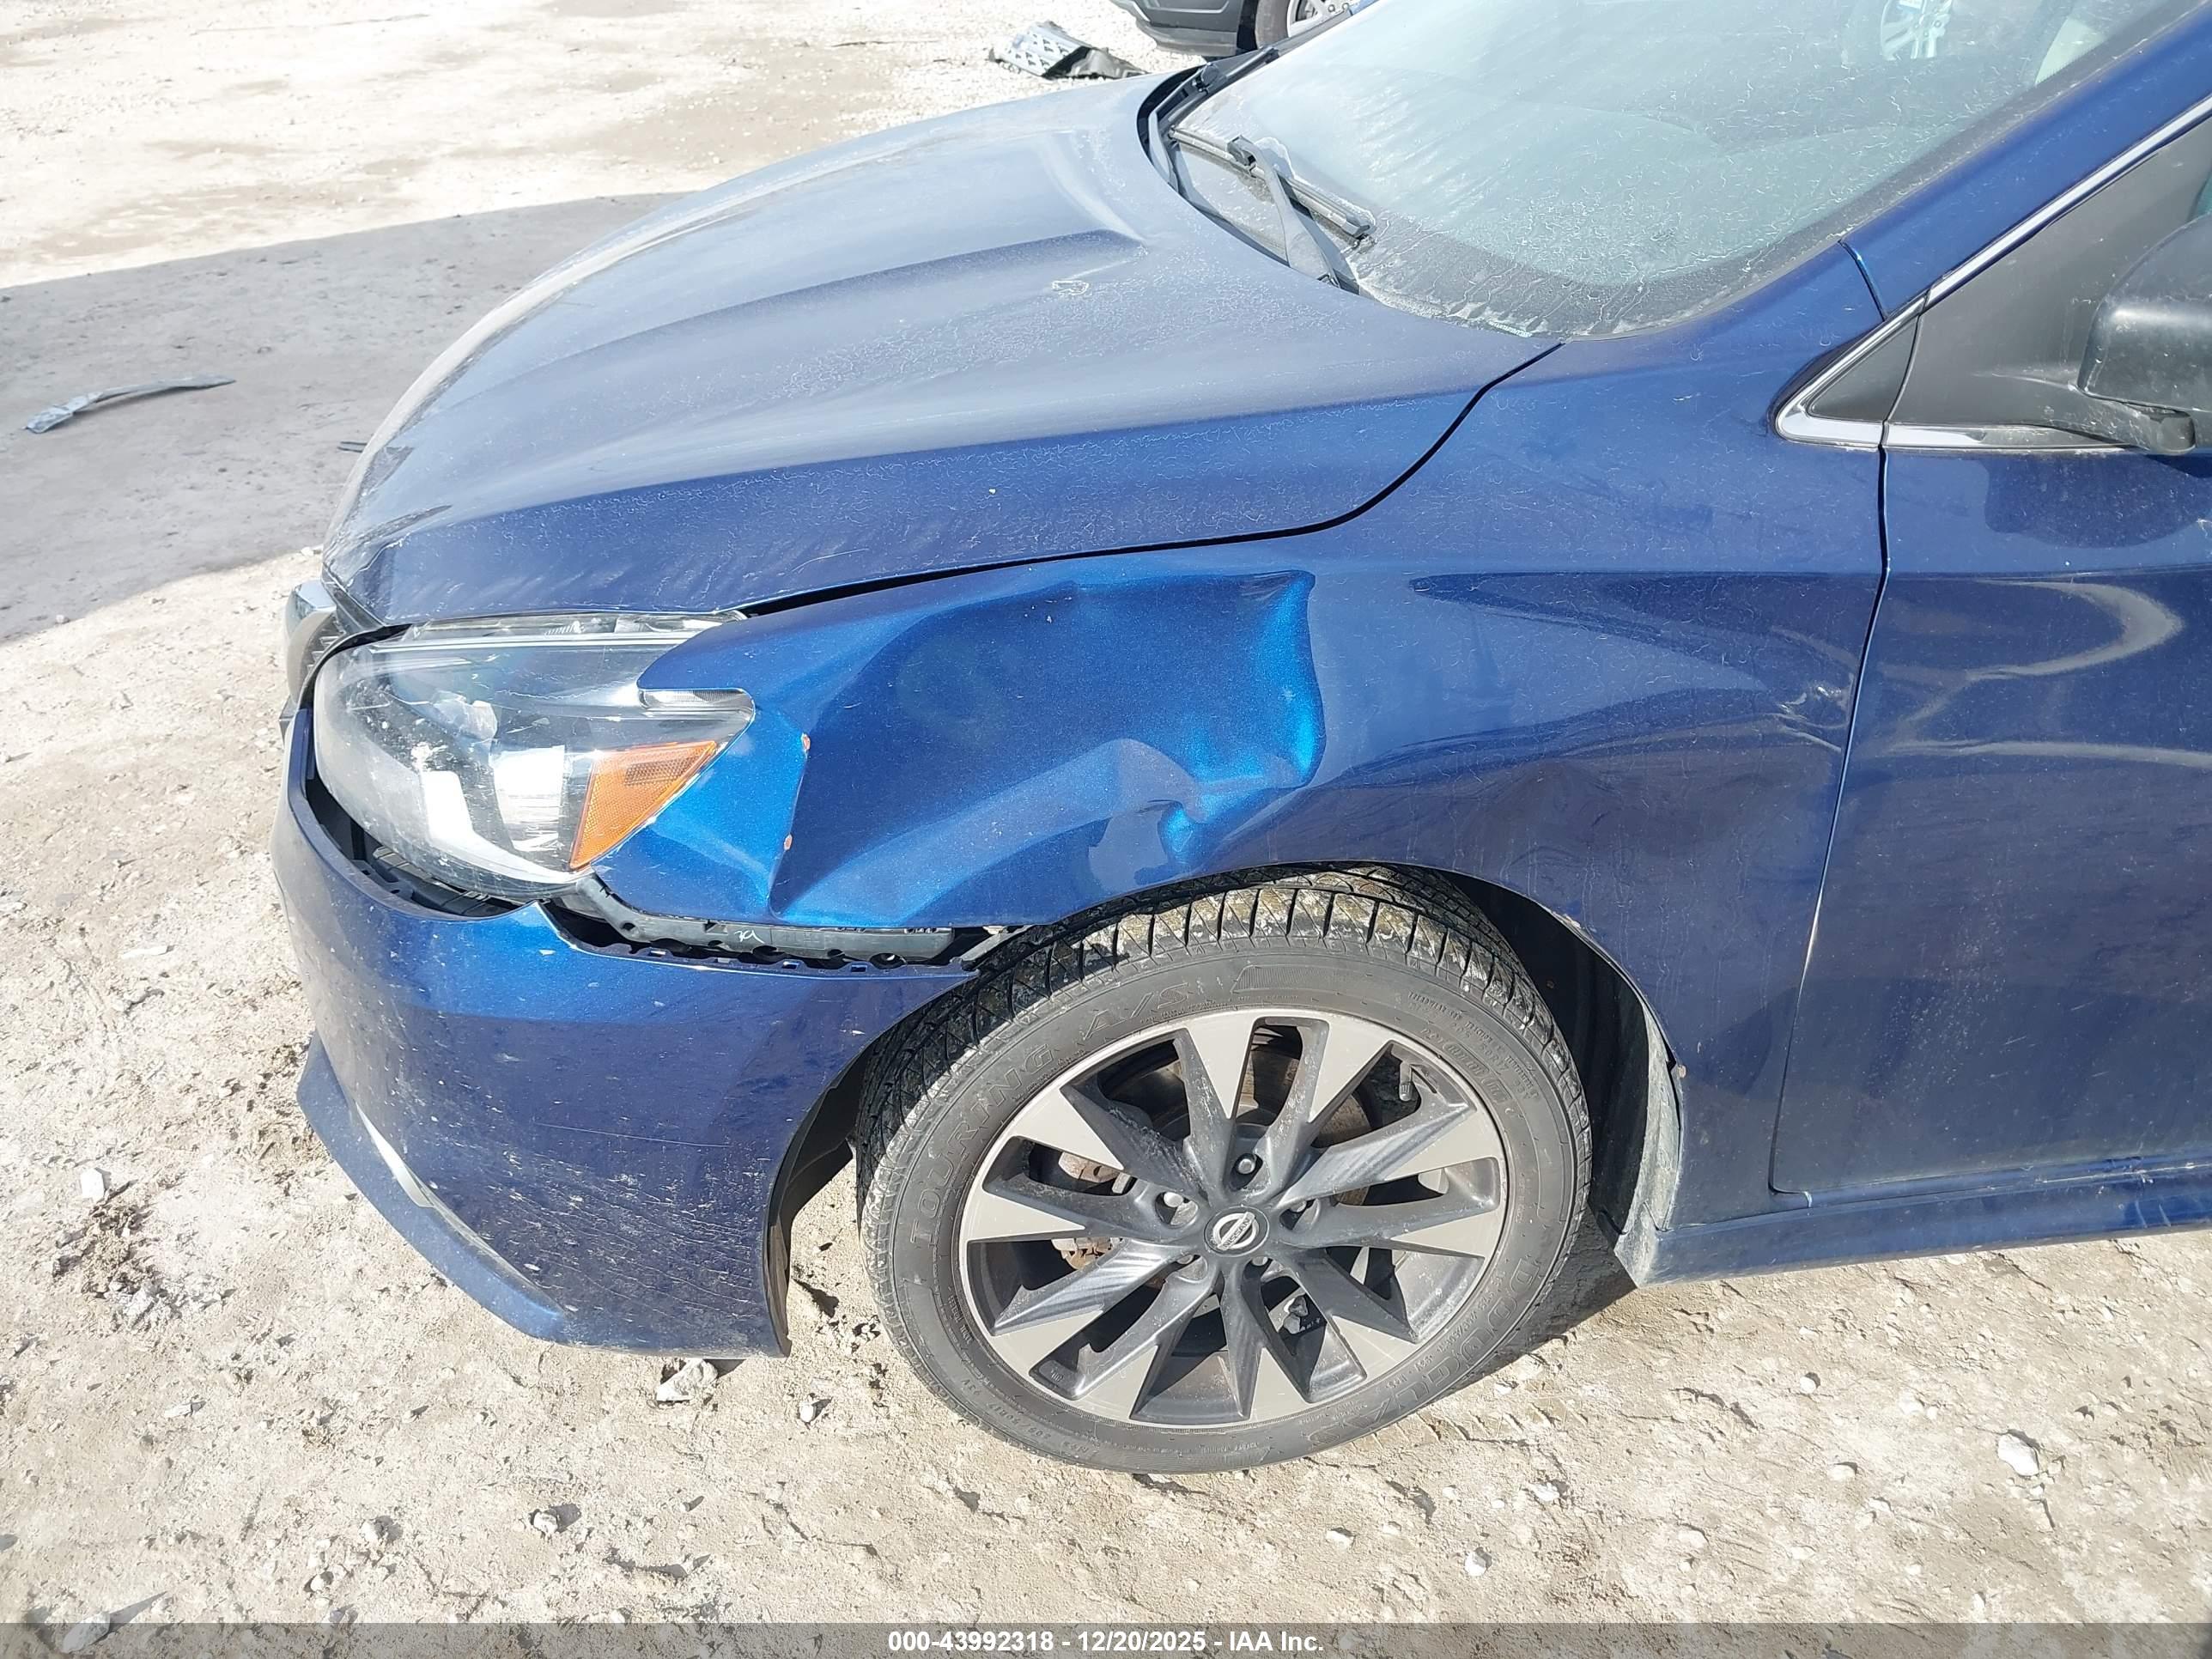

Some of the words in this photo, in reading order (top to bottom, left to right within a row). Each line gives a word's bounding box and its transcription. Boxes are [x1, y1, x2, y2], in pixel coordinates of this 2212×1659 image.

[910, 1041, 1060, 1244] TOURING
[1073, 981, 1191, 1040] A/S
[1223, 1218, 1250, 1248] NISSAN
[1304, 1257, 1544, 1450] DOUGLAS
